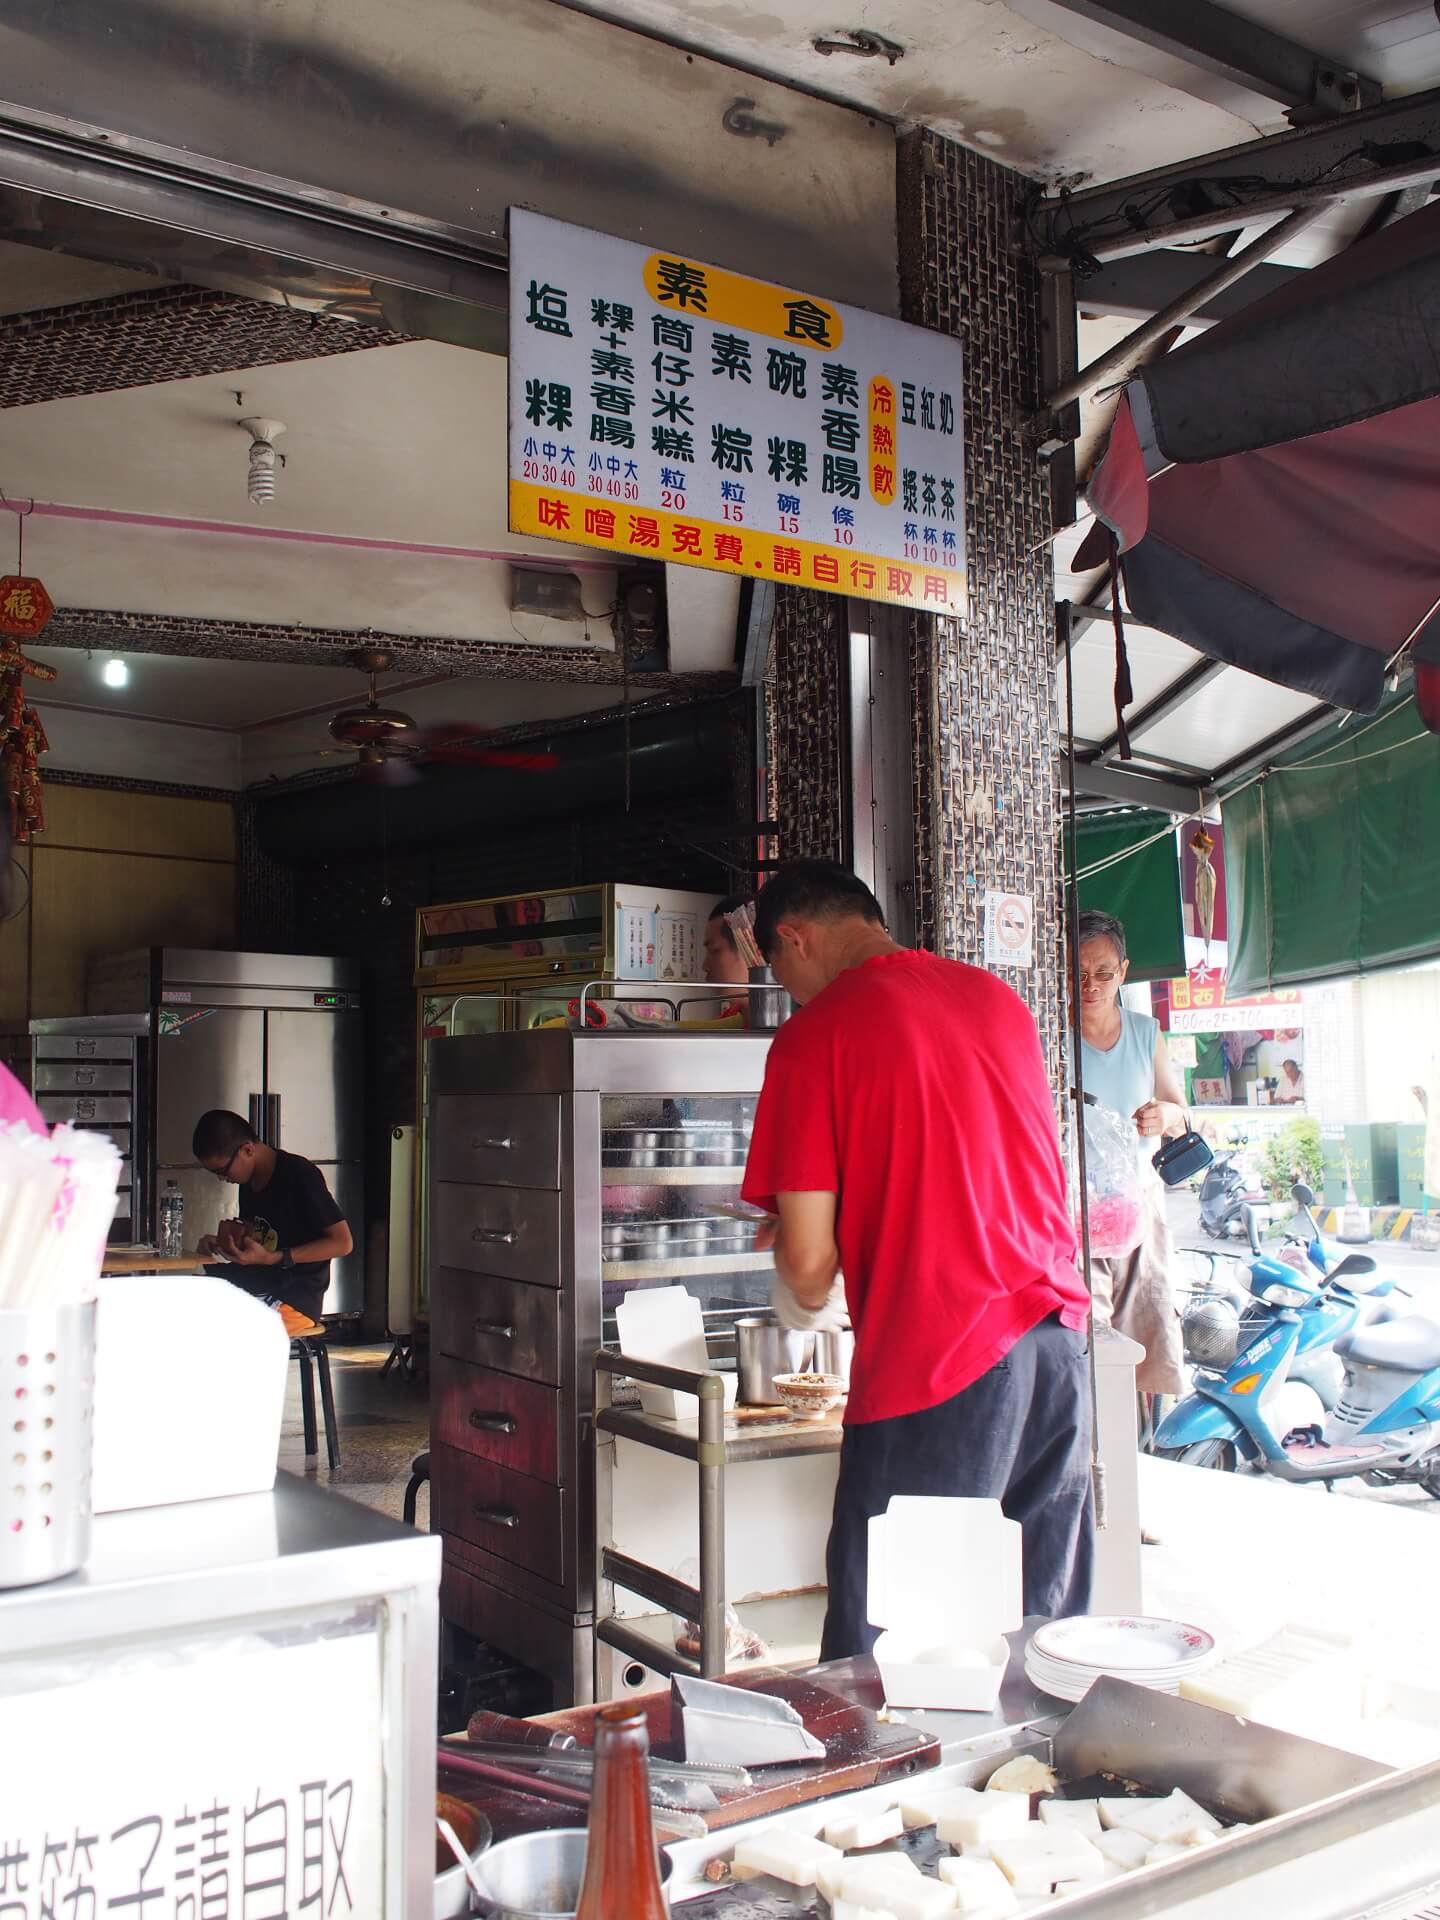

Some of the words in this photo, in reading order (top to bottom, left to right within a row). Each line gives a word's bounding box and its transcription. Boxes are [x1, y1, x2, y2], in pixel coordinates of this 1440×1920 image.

[657, 259, 832, 348] 素食
[651, 314, 695, 463] 筒仔米糕
[767, 347, 808, 487] 碗粿
[821, 363, 861, 500] 素香腸
[872, 383, 894, 497] 冷熱飲
[920, 387, 937, 518] 紅茶
[940, 391, 955, 522] 奶茶
[523, 460, 539, 480] 20
[542, 465, 557, 483] 30
[560, 470, 576, 488] 40
[588, 474, 603, 493] 30
[606, 479, 621, 497] 40
[624, 482, 639, 500] 50
[660, 467, 687, 491] 粒
[660, 490, 686, 511] 20
[721, 480, 746, 503] 粒
[777, 492, 801, 516] 碗
[722, 503, 744, 522] 15
[778, 516, 799, 534] 15
[832, 505, 854, 527] 條
[833, 527, 854, 546] 10
[904, 543, 919, 560] 10
[923, 547, 938, 564] 10
[942, 551, 957, 568] 10
[4, 589, 37, 620] 福
